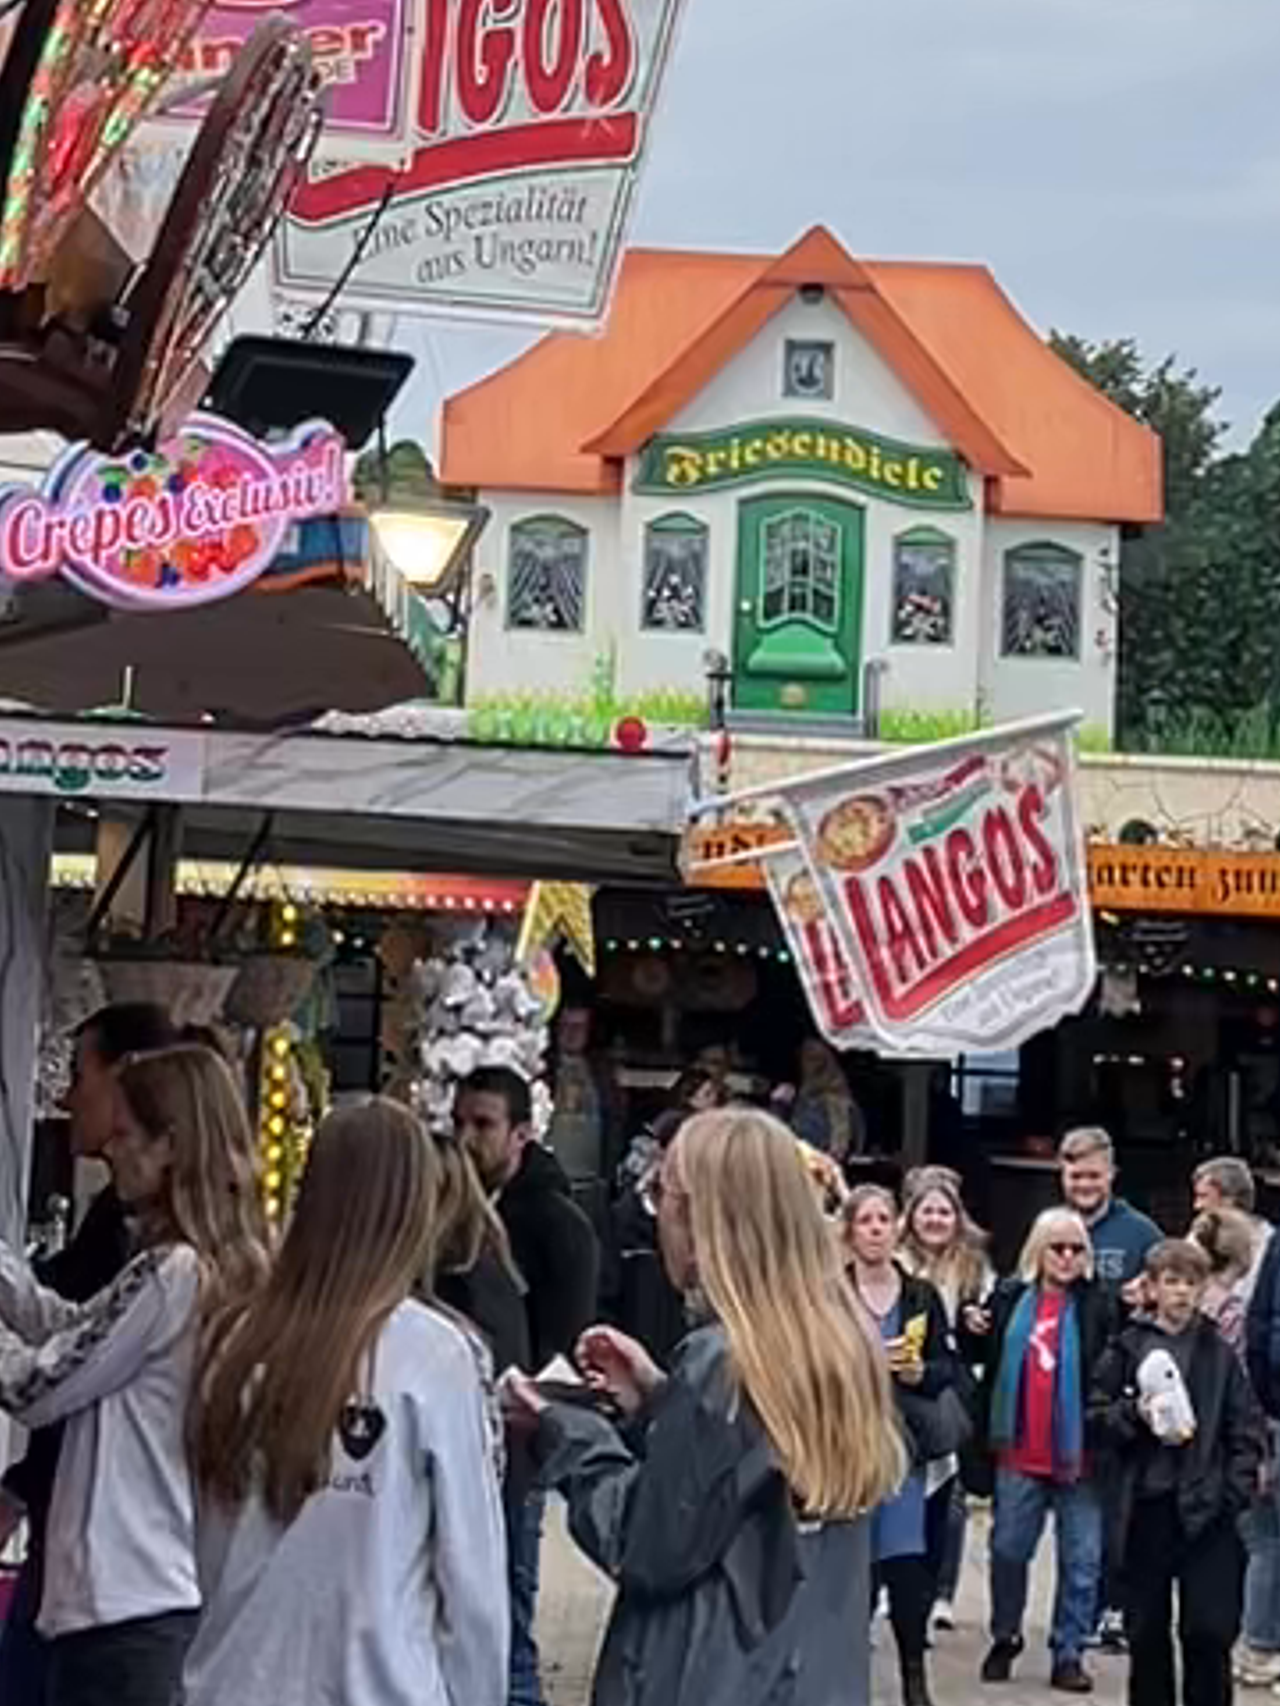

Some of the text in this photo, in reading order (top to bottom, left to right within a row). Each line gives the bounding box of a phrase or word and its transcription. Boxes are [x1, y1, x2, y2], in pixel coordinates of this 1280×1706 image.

[424, 184, 587, 242] Spezialität
[417, 231, 597, 284] aus Ungarn!
[1094, 863, 1198, 891] arten
